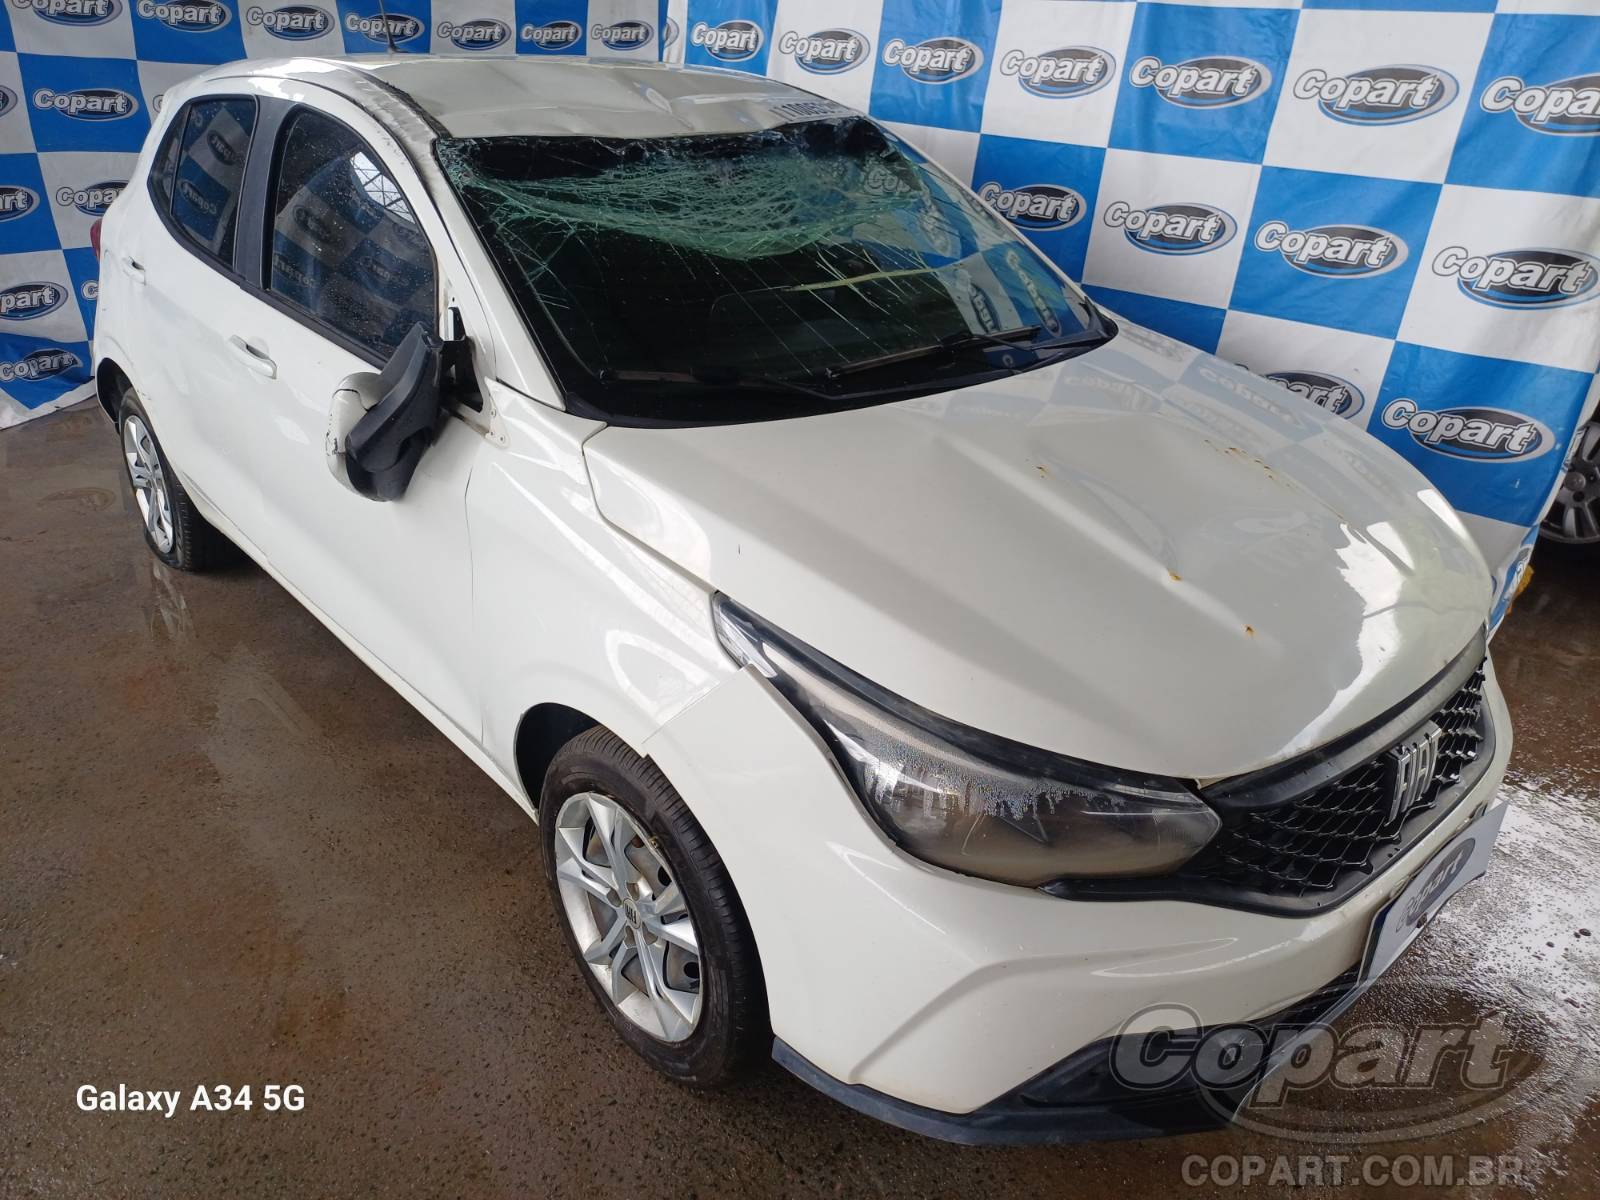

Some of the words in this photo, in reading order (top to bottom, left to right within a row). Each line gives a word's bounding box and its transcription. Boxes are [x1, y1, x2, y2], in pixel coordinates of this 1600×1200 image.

[138, 0, 221, 25] Copart
[247, 7, 325, 31] Copart
[345, 14, 416, 37] Copart
[437, 22, 504, 44] Copart
[520, 24, 577, 44] Copart
[591, 24, 647, 43] Copart
[691, 22, 758, 52] Copart
[778, 31, 861, 61] Copart
[882, 39, 973, 74] Copart
[1000, 49, 1104, 86] Copart
[1129, 56, 1258, 97] Copart
[1293, 69, 1438, 110] Copart
[33, 89, 129, 115] Copart
[1480, 76, 1600, 124] Copa
[56, 186, 123, 210] Copa
[978, 182, 1078, 222] Copart
[1104, 201, 1223, 241] Copart
[1255, 221, 1393, 266] Copart
[1432, 246, 1599, 295] Copart
[0, 352, 74, 381] Copart
[1381, 397, 1538, 453] Copart
